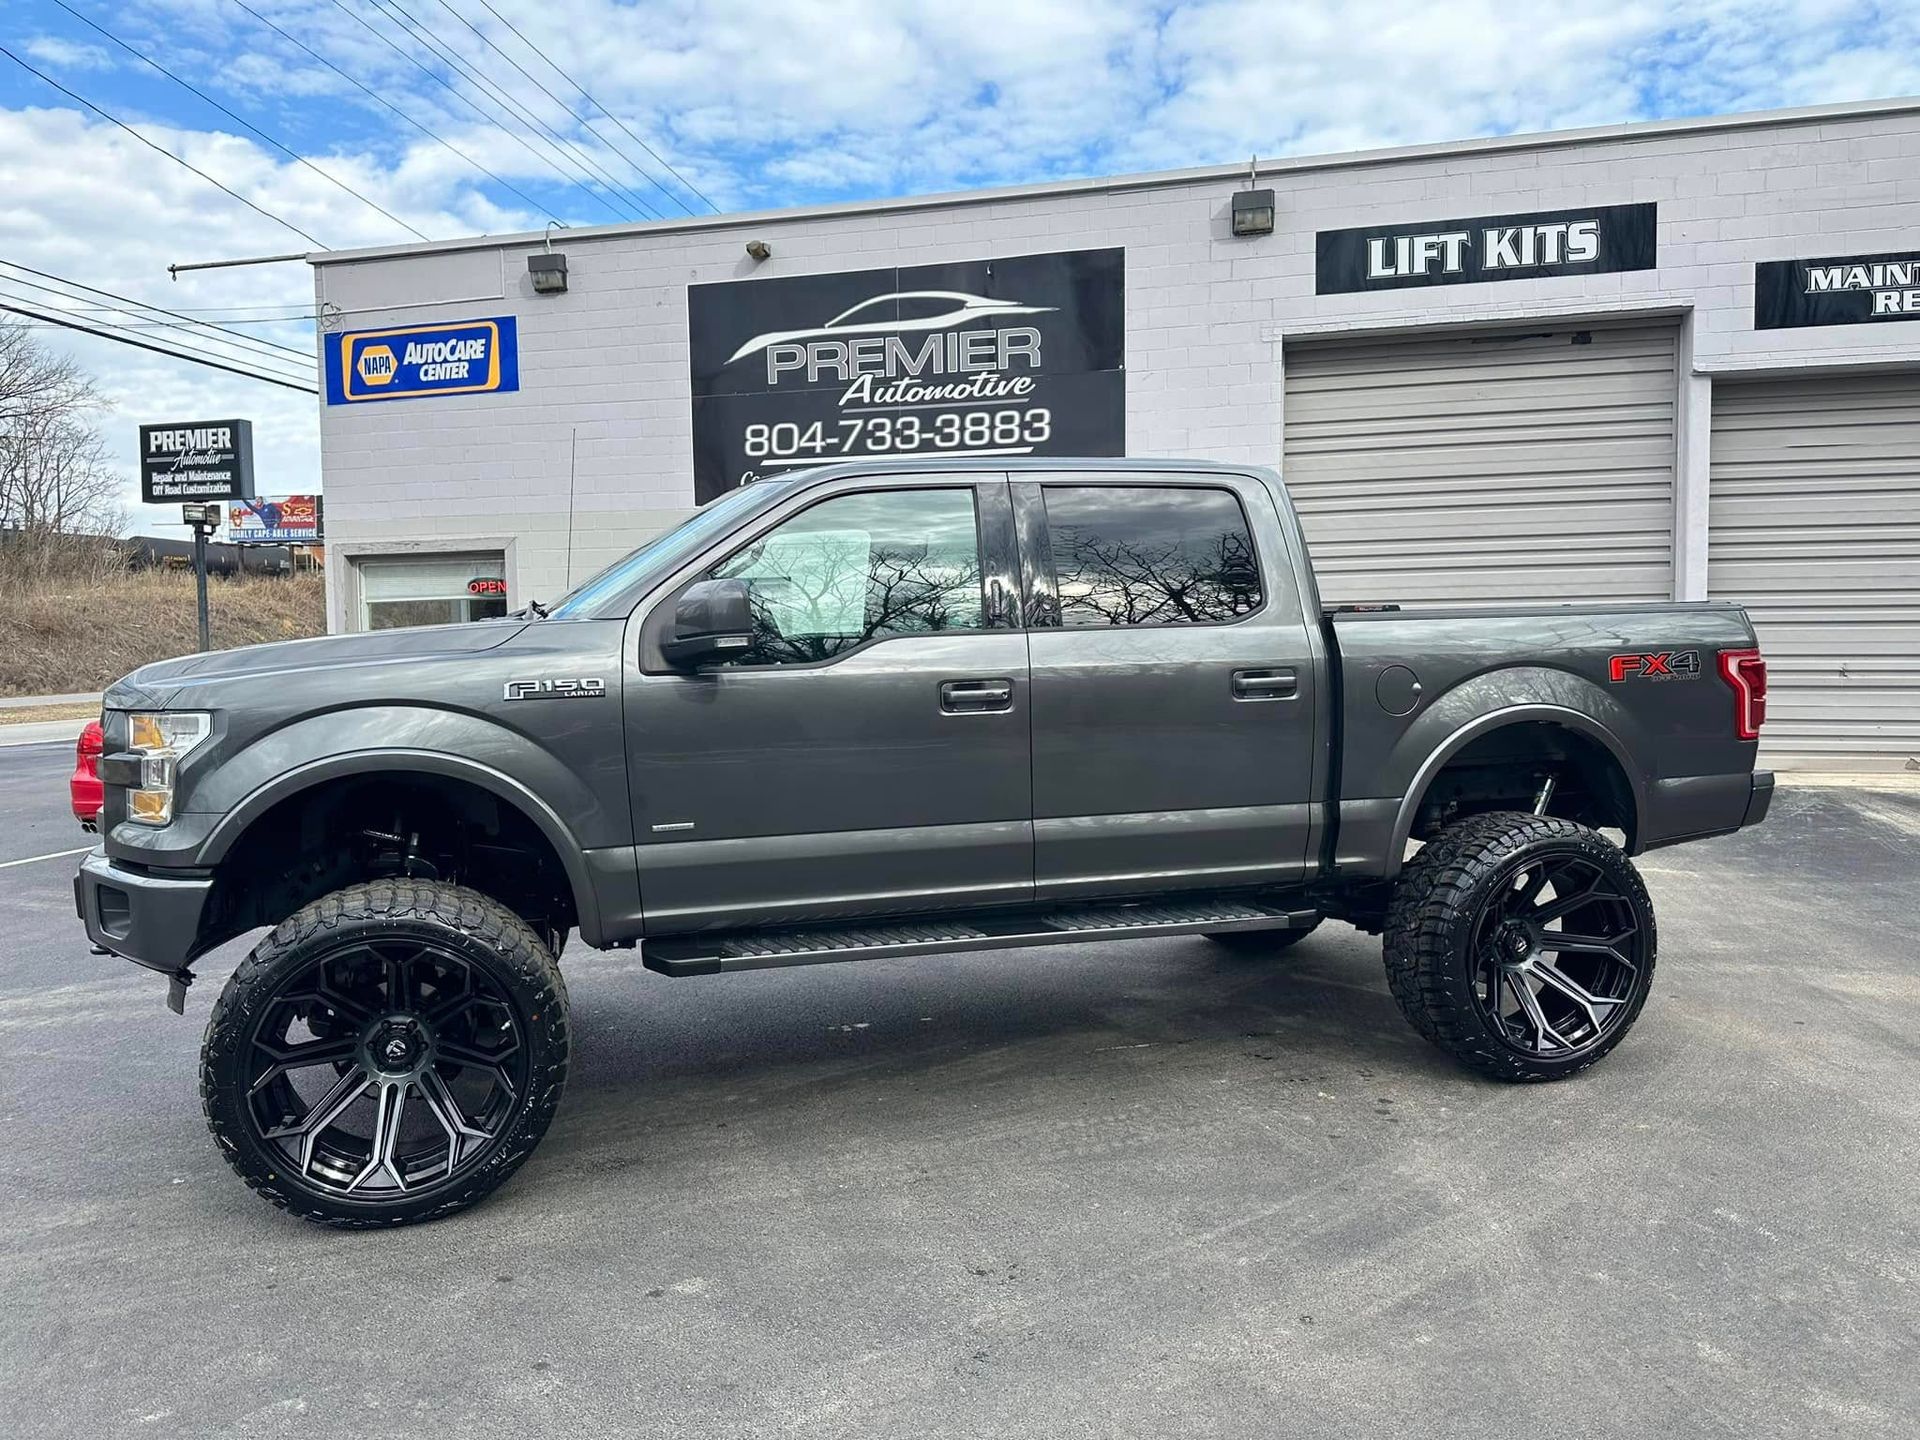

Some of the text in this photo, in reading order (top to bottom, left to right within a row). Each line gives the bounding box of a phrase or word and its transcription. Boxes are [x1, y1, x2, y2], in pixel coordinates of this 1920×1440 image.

[1366, 218, 1601, 280] LIFT KITS
[363, 355, 393, 376] NAPA
[766, 326, 1042, 386] PREMIER
[419, 361, 469, 382] CENTER
[838, 370, 1036, 407] Automotive
[148, 426, 232, 453] PREMIER
[744, 408, 1052, 458] 804-733-3883
[171, 447, 222, 471] Automotive
[151, 469, 232, 485] Repair and Maintenance
[152, 481, 232, 496] Off Road Customization
[290, 528, 316, 538] SERVICE
[468, 580, 508, 594] OPEN
[1608, 650, 1701, 684] FX4
